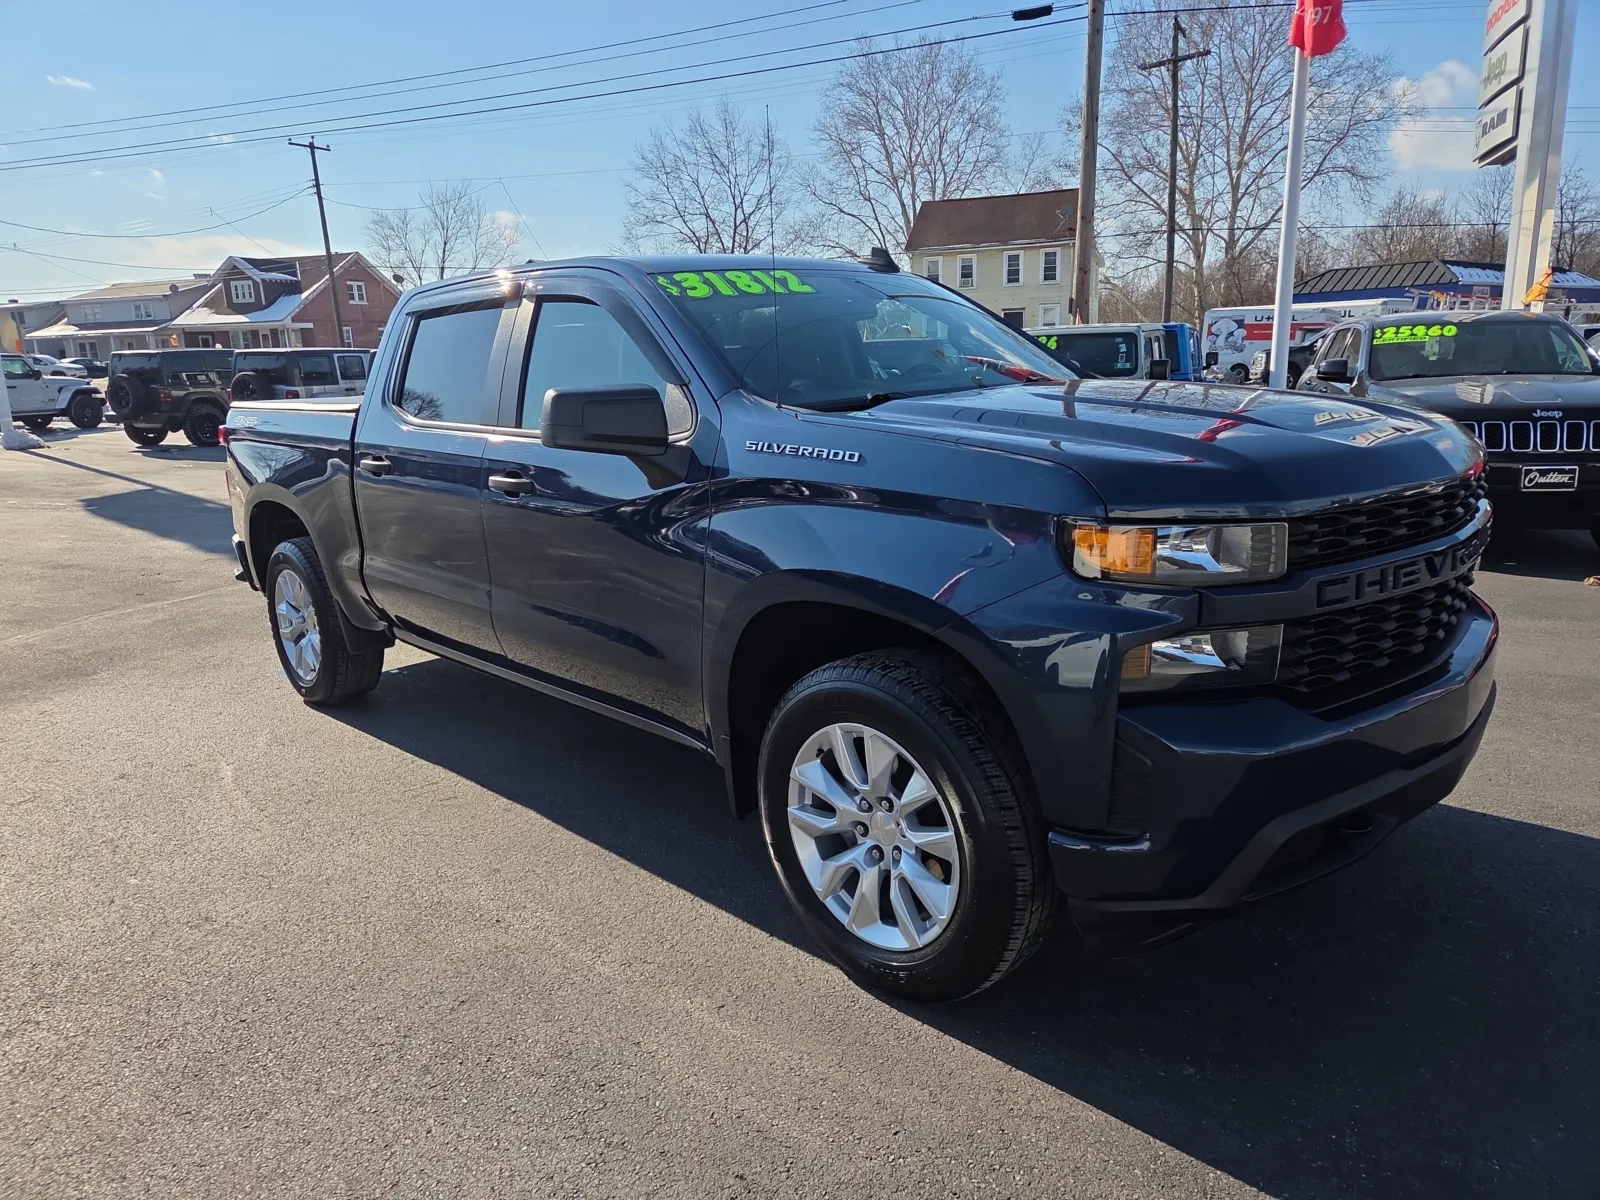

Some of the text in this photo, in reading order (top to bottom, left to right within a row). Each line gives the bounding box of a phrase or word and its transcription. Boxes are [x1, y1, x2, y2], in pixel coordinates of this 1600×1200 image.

[1483, 51, 1507, 90] Jeep
[1481, 107, 1508, 138] RAM
[657, 270, 816, 298] $31812
[1375, 325, 1458, 338] $25460
[1533, 409, 1563, 418] Jeep
[744, 440, 861, 462] SILVERADO
[1524, 471, 1575, 487] Outten
[1316, 540, 1478, 609] CHEVR
